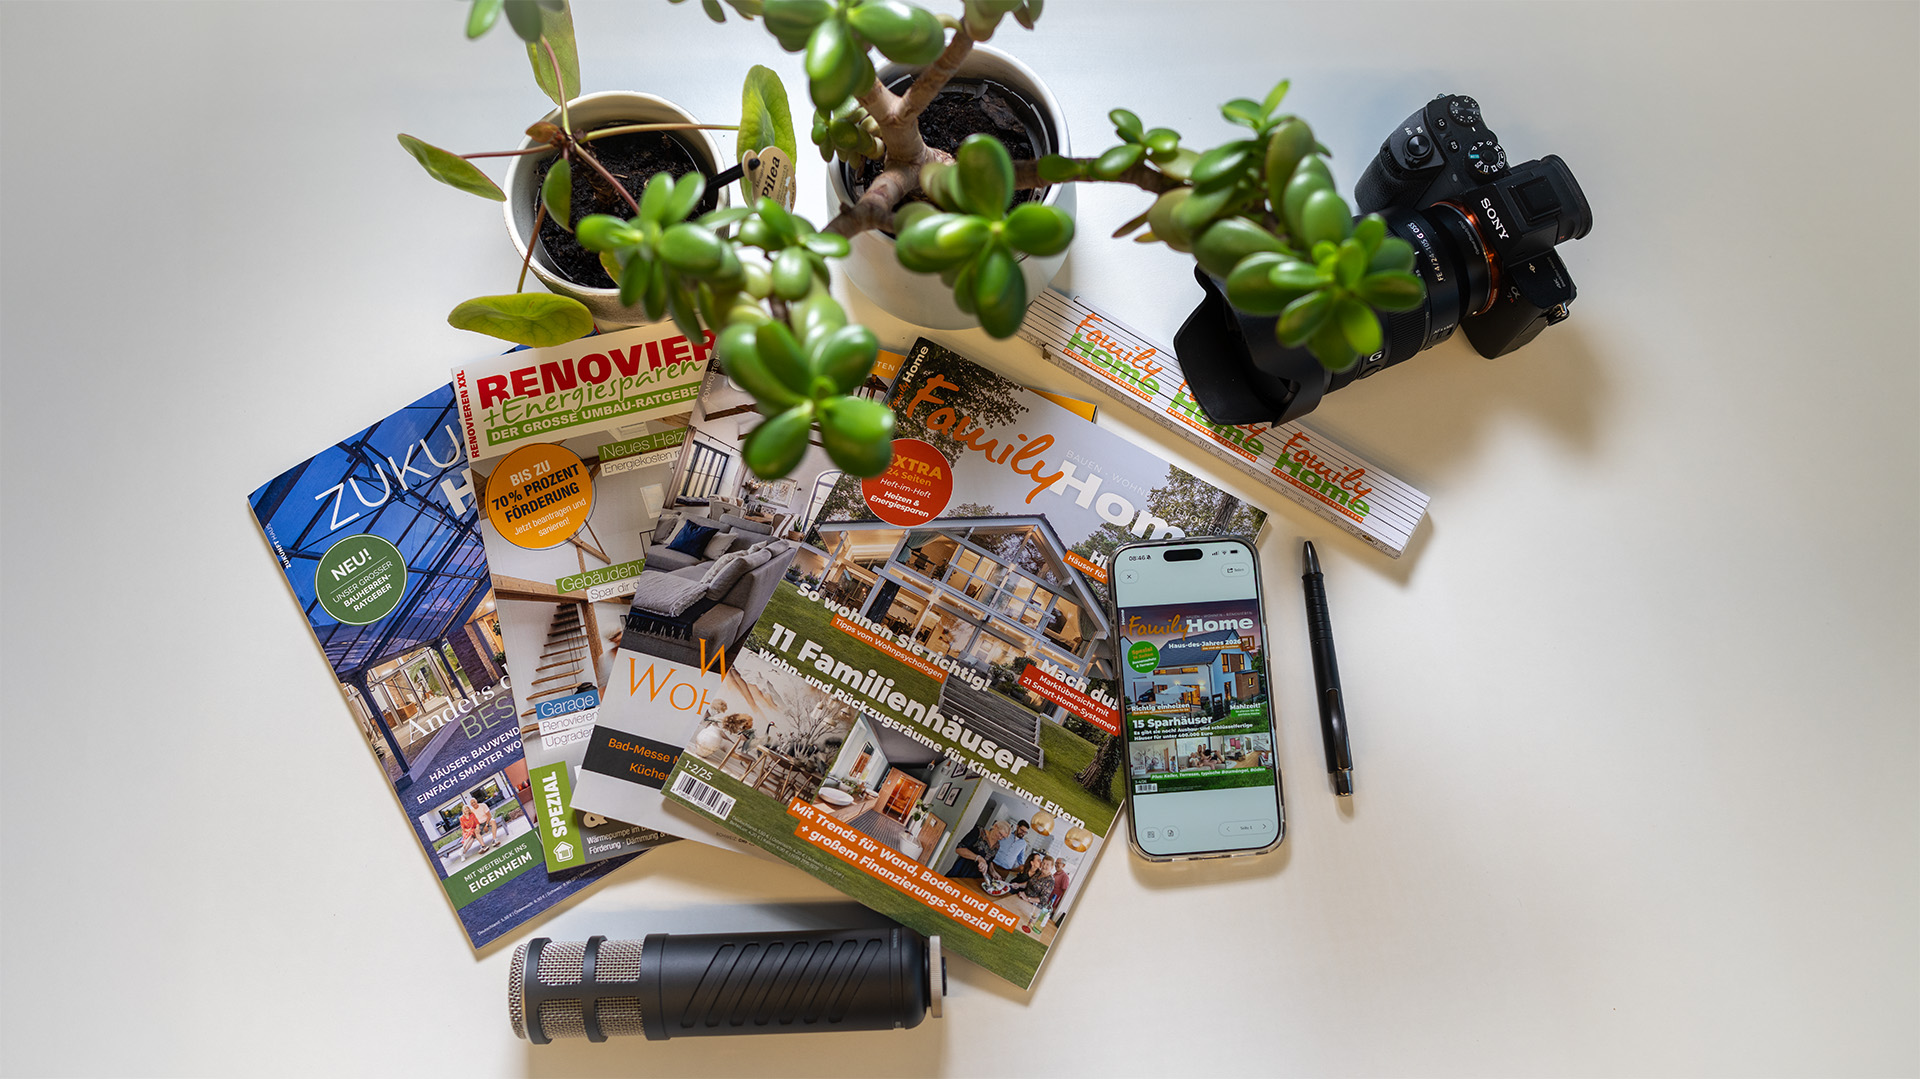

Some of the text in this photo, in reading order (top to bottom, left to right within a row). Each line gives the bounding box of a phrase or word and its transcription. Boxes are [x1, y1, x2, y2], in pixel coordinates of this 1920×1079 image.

[762, 156, 781, 199] Pilea
[1481, 198, 1509, 239] SONY
[873, 361, 896, 372] TEN
[1065, 332, 1160, 396] Home
[1075, 313, 1163, 383] Family
[887, 346, 929, 412] Family Home
[457, 370, 480, 459] RENOVIEREN XXL
[491, 385, 703, 443] DER GROSSE UMBAU-RATGEBE
[603, 437, 651, 459] Neues
[906, 373, 1065, 505] Family
[315, 420, 464, 531] ZUKU
[509, 460, 551, 487] BIS ZU
[524, 463, 580, 497] PROZENT
[604, 452, 674, 474] Energiekosten
[885, 467, 932, 487] 24 Seiten
[1066, 449, 1103, 473] BAUEN
[1112, 473, 1160, 503] WOHNEN
[1282, 432, 1372, 504] Family
[504, 482, 580, 523] FÖRDERUNG
[879, 477, 932, 499] Heft-im-Heft
[883, 490, 921, 507] Heizen &
[1049, 460, 1186, 540] Hom
[1274, 451, 1370, 517] Home
[514, 497, 587, 536] Jetzt beantragen und
[538, 516, 571, 537] sanieren!
[870, 495, 930, 518] Energiesparen
[272, 538, 292, 569] ZUKUNFT
[331, 548, 372, 581] NEU!
[1067, 554, 1094, 573] Häuser
[1094, 568, 1107, 580] für
[332, 560, 393, 603] UNSER GROSSER
[343, 573, 392, 608] BAUHERREN-
[353, 583, 393, 612] RATGEBER
[590, 586, 615, 600] Spar
[617, 582, 630, 593] dir
[797, 582, 992, 691] So wohnen Sie richtig!
[835, 617, 943, 679] Tipps vom Wohnpsychologen
[1128, 614, 1189, 641] Family
[1186, 617, 1254, 633] Home
[1168, 641, 1224, 649] Haus-des-Jahres
[768, 622, 797, 653] 11
[797, 639, 1029, 776] Familienhäuser
[1022, 676, 1117, 732] 21 Smart-Home-Systemen
[1039, 675, 1109, 718] Marktübersicht mit
[1040, 658, 1120, 711] Mach du!
[408, 685, 495, 744] Anders
[459, 695, 516, 740] BES
[541, 695, 594, 717] Garage
[1132, 715, 1213, 729] 15 Sparhäuser
[608, 738, 670, 763] Bad-Messe
[758, 647, 803, 677] Wohn-
[804, 674, 834, 695] und
[833, 687, 943, 752] Rückzugsräume
[944, 747, 967, 764] für
[967, 759, 1014, 791] Kinder
[1015, 786, 1044, 808] und
[1043, 800, 1086, 830] Eltern
[416, 739, 524, 804] EINFACH SMARTER WO
[429, 754, 472, 782] HÄUSER:
[684, 760, 714, 781] 1-2/25
[542, 771, 568, 838] SPEZIAL
[586, 828, 631, 845] Wärmepumpe
[589, 841, 622, 855] Förderung
[625, 831, 659, 846] Dämmung
[463, 842, 527, 882] MIT WEITBLICK INS
[468, 851, 533, 894] EIGENHEIM
[792, 802, 1017, 927] Mit Trends für Wand, Boden und Bad
[808, 830, 859, 861] großem
[859, 855, 994, 933] Finanzierungs-Spezial
